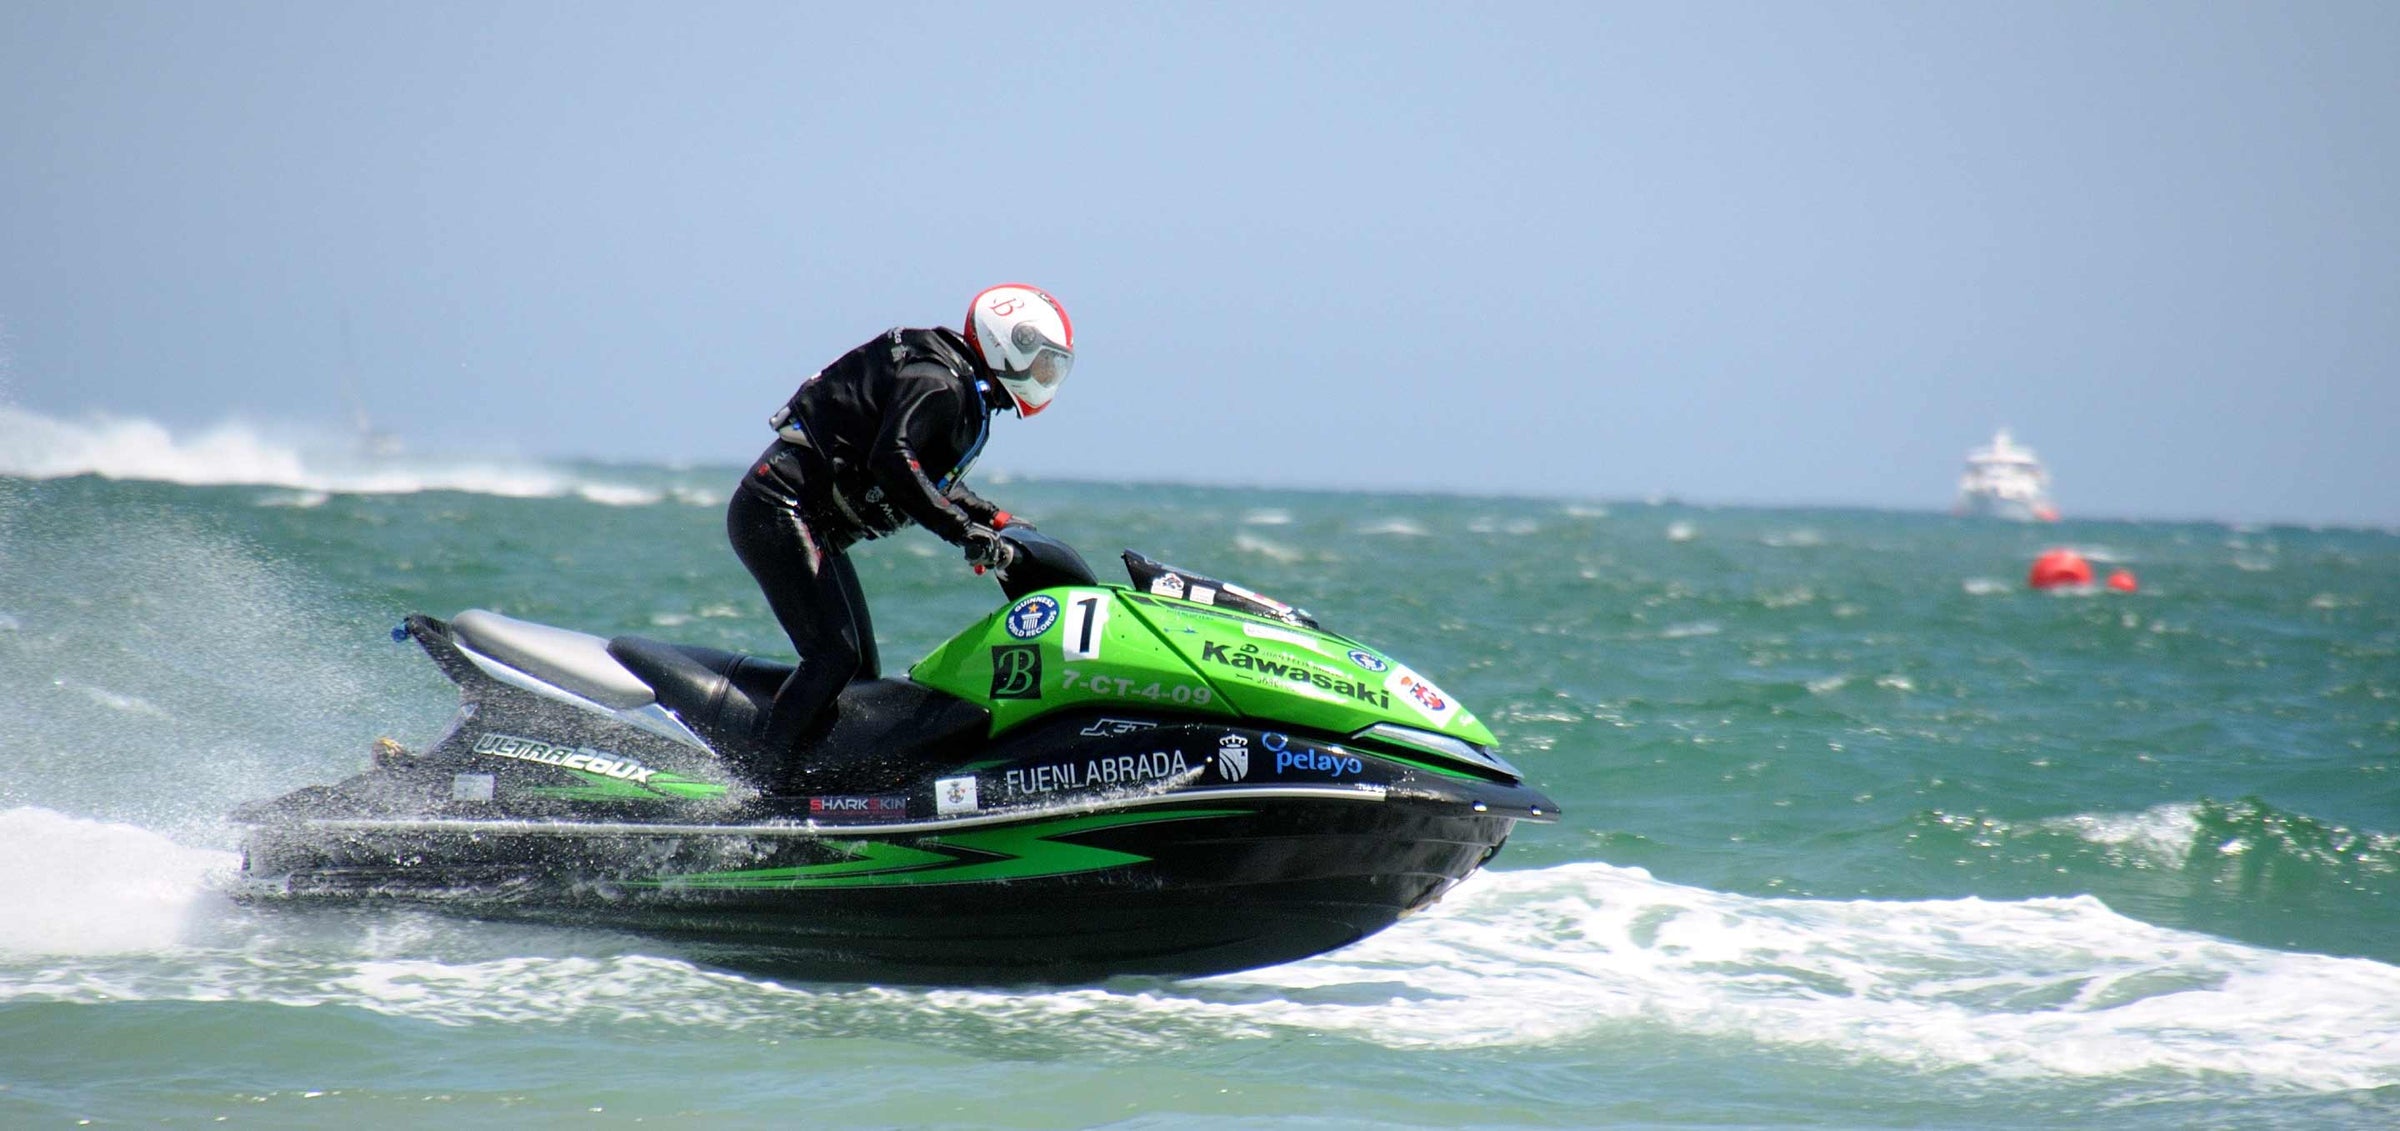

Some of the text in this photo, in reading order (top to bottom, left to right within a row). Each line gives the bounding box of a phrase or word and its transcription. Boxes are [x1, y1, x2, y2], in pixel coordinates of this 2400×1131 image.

[1008, 610, 1057, 638] WORLD RECORDS
[1014, 596, 1055, 612] GUINNESS
[1076, 597, 1098, 653] 1
[995, 648, 1036, 695] B
[1062, 669, 1212, 705] 7-CT-4-09
[1201, 639, 1390, 711] Kawasaki
[1005, 749, 1188, 796] FUENLABRADA
[1276, 747, 1363, 777] pelayo
